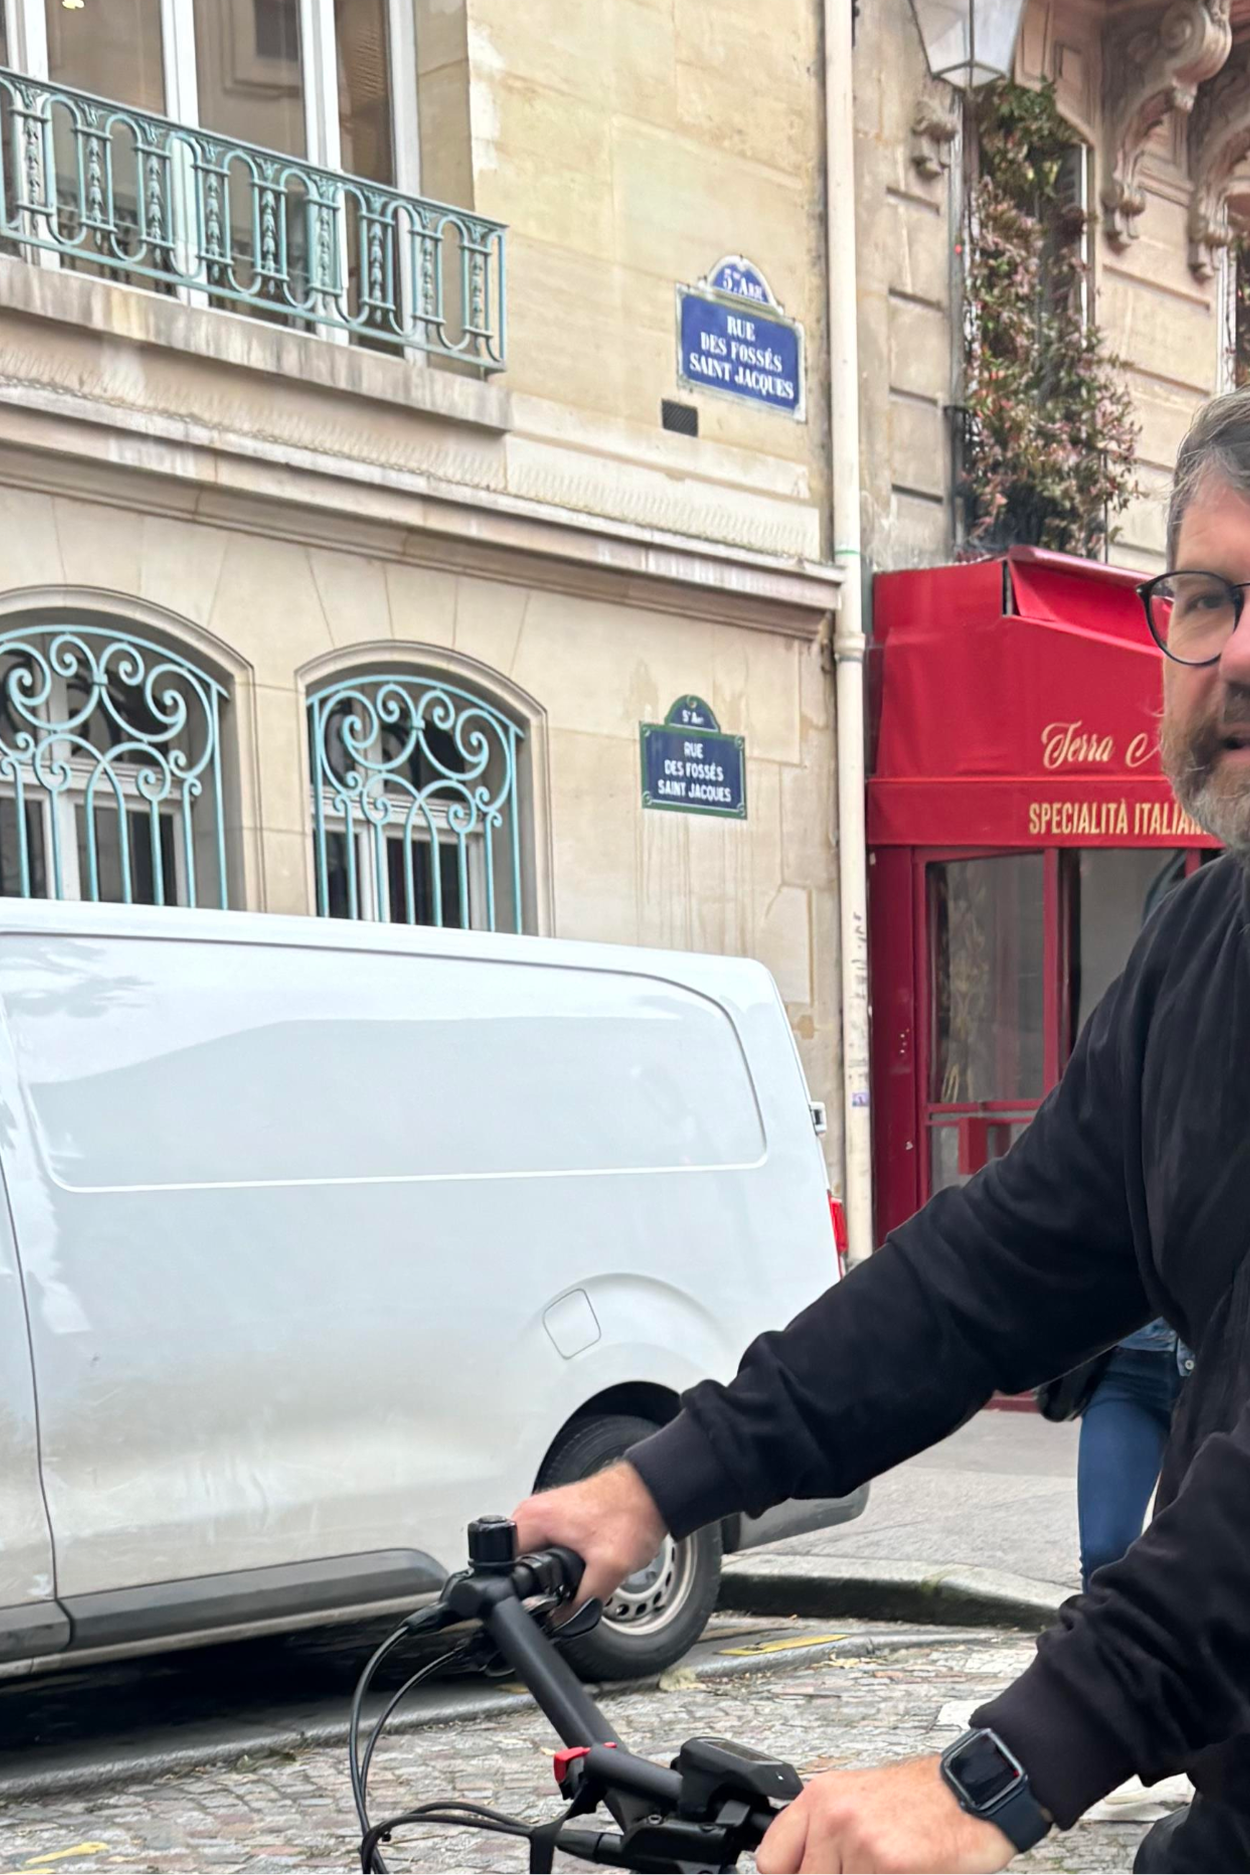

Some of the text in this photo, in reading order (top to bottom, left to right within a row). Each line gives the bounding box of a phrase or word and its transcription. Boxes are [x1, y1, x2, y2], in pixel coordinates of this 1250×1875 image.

[727, 315, 756, 341] RUE
[701, 331, 783, 373] DES FOSSÉS
[689, 352, 795, 400] SAINT JACQUES
[683, 741, 704, 759] RUE
[1041, 719, 1114, 769] Terra
[664, 759, 724, 781] DES FOSSÉS
[657, 779, 732, 802] SAINT JACQUES
[1029, 798, 1209, 835] SPECIALITÀ ITALIA
